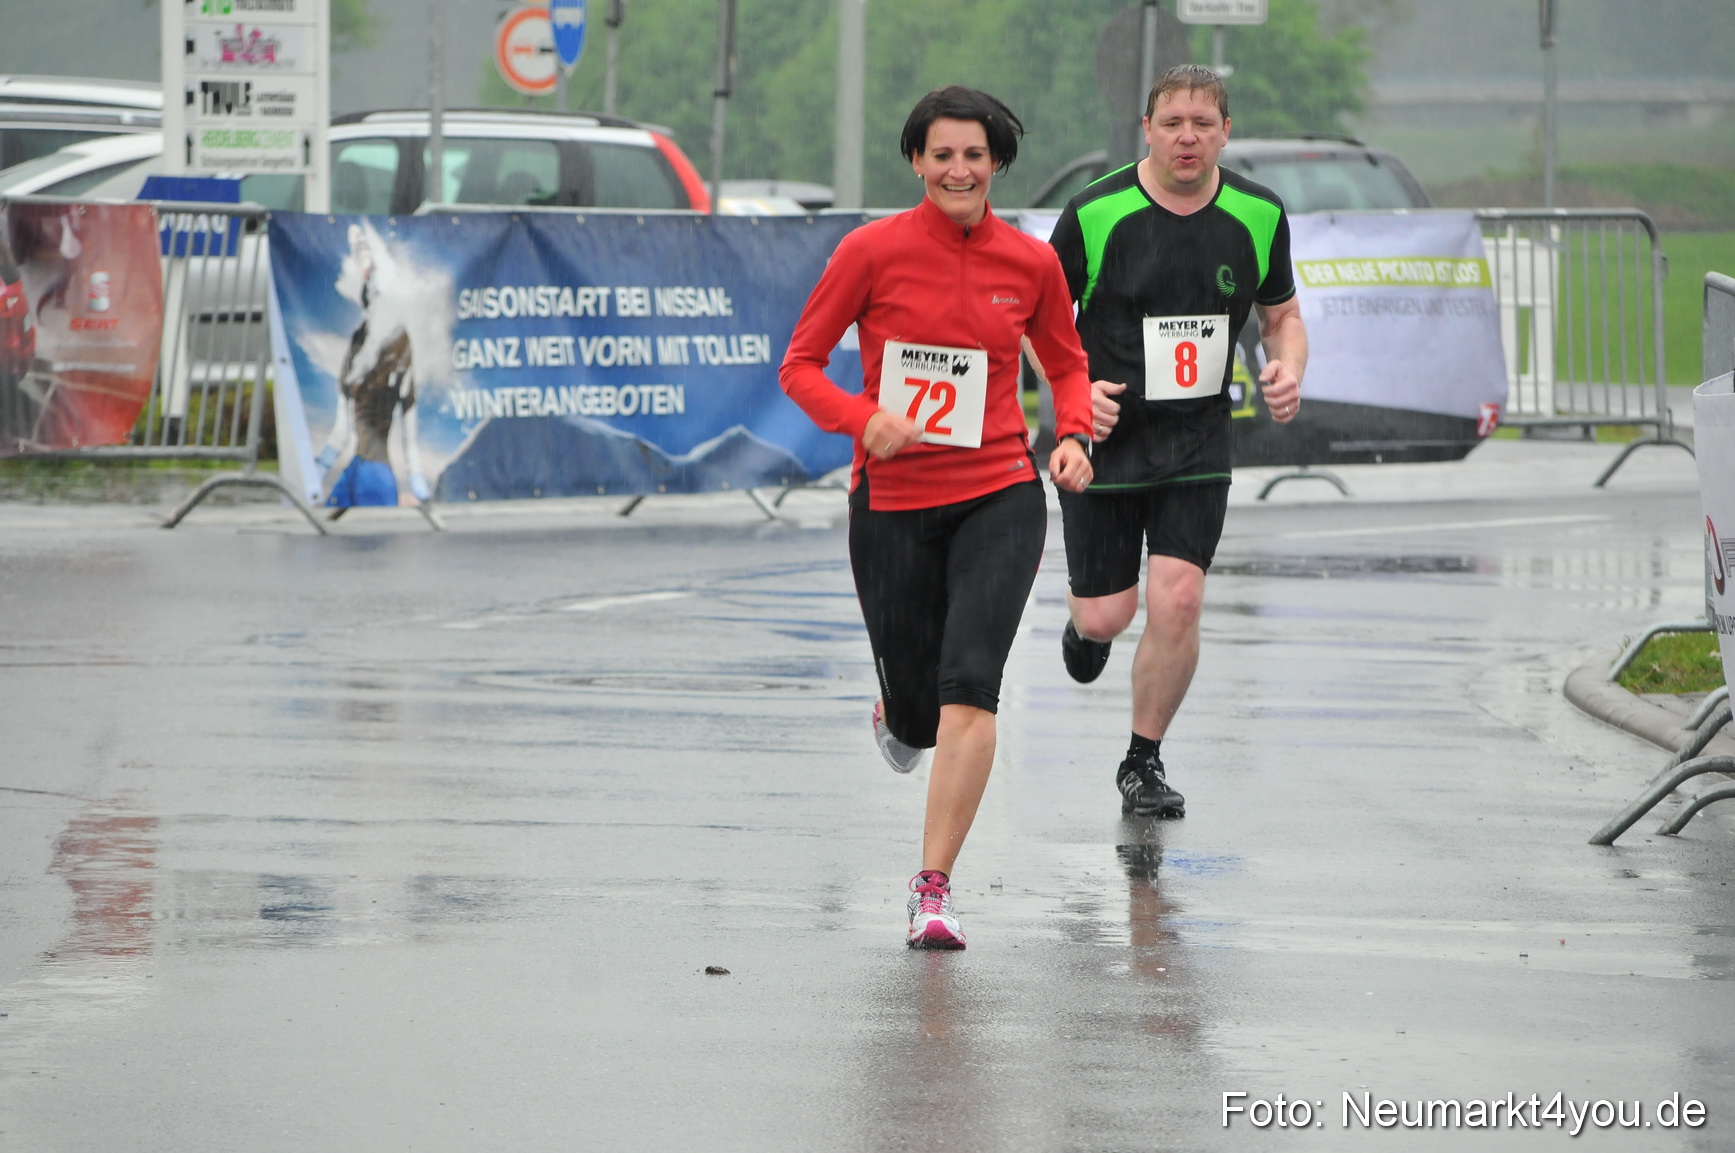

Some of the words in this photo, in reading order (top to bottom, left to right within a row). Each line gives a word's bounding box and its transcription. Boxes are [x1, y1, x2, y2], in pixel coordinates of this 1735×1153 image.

[1303, 262, 1338, 284] DER
[1337, 262, 1378, 283] NEUE
[1377, 261, 1434, 283] PICANTO
[458, 285, 611, 319] SAISONSTART
[615, 286, 651, 317] BEI
[654, 286, 733, 317] NISSAN:
[69, 318, 119, 331] SEAT
[1159, 320, 1198, 330] MEYER
[1160, 330, 1199, 338] WERBUNG
[452, 337, 522, 370] GANZ
[524, 336, 576, 367] WEIT
[578, 335, 652, 367] VORN
[656, 335, 690, 365] MIT
[692, 334, 771, 365] TOLLEN
[901, 349, 949, 363] MEYER
[901, 360, 949, 373] WERBUNG
[1174, 341, 1198, 388] 8
[452, 384, 685, 419] WINTERANGEBOTEN
[904, 377, 957, 436] 72
